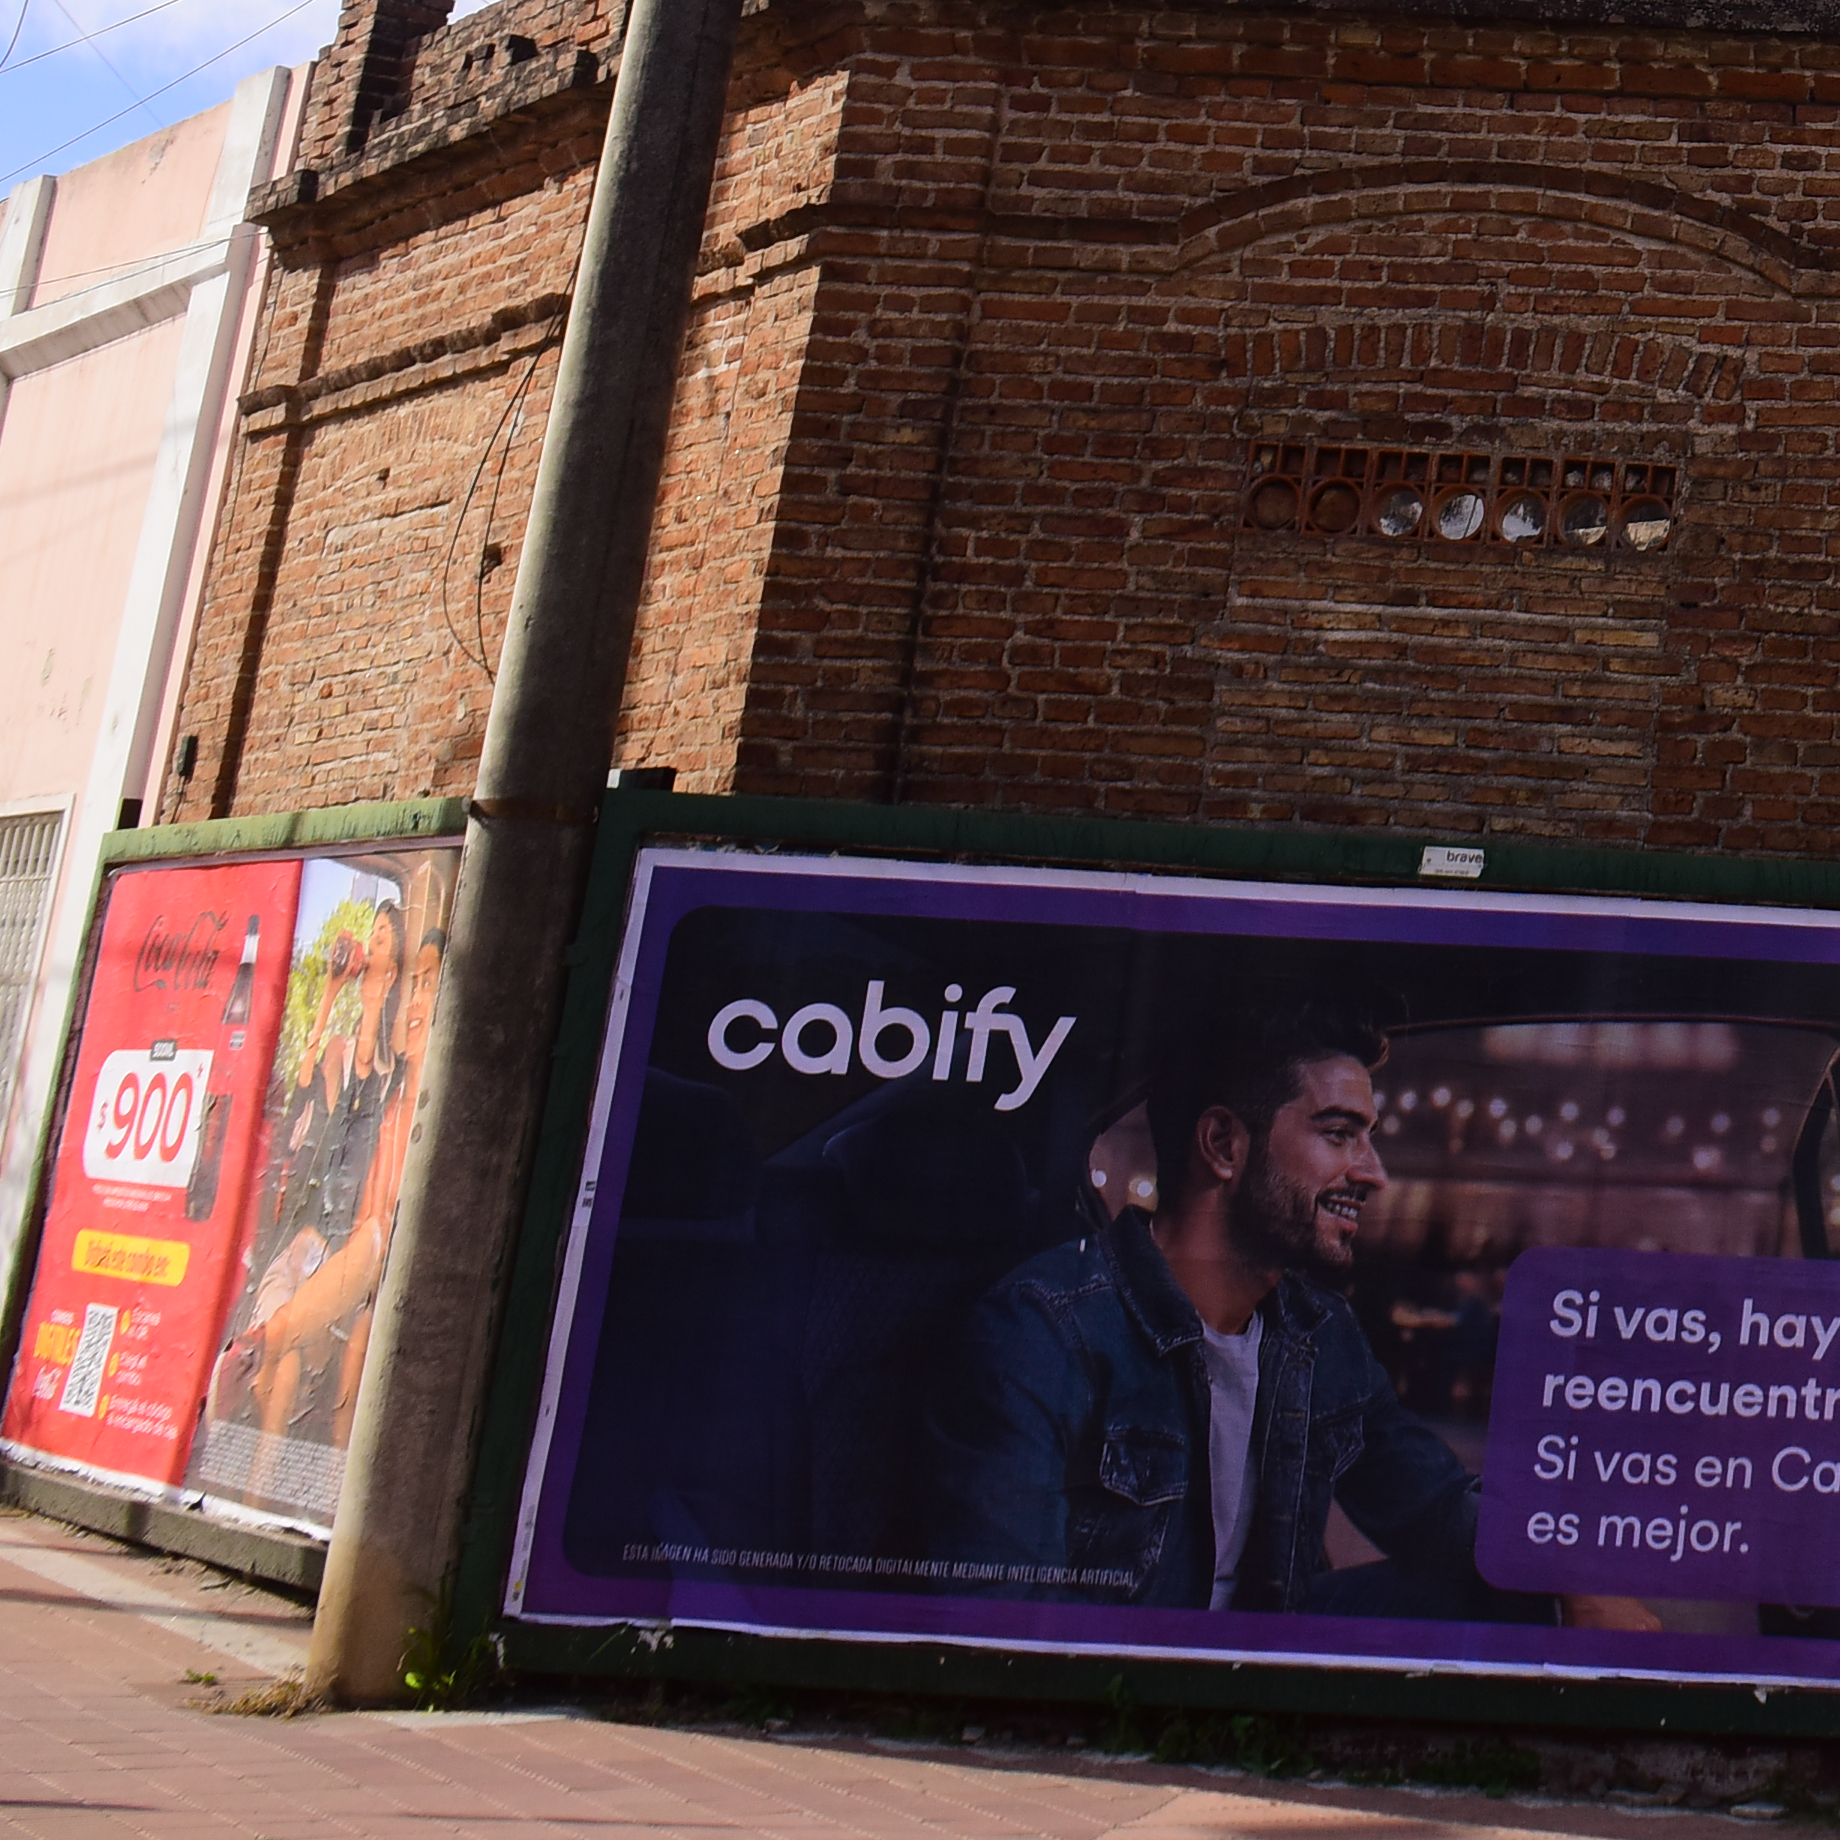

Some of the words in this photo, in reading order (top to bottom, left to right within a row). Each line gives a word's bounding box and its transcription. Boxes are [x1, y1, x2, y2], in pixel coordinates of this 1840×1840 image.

[707, 980, 1077, 1111] cabify
[1550, 1289, 1600, 1341] Si
[1613, 1304, 1722, 1355] vas,
[1533, 1435, 1578, 1483] Si
[1593, 1446, 1678, 1487] vas
[1694, 1452, 1754, 1490] en
[1526, 1510, 1580, 1547] es
[1597, 1503, 1751, 1561] mejor.
[622, 1544, 648, 1561] ESTA
[693, 1546, 709, 1563] HA
[710, 1547, 737, 1566] SIDO
[739, 1549, 794, 1569] GENERADA
[818, 1554, 872, 1574] RETOCADA
[875, 1557, 949, 1578] DIGITALMENTE
[952, 1560, 1004, 1581] MEDIANTE
[1007, 1564, 1077, 1584] INTELIGENCIA
